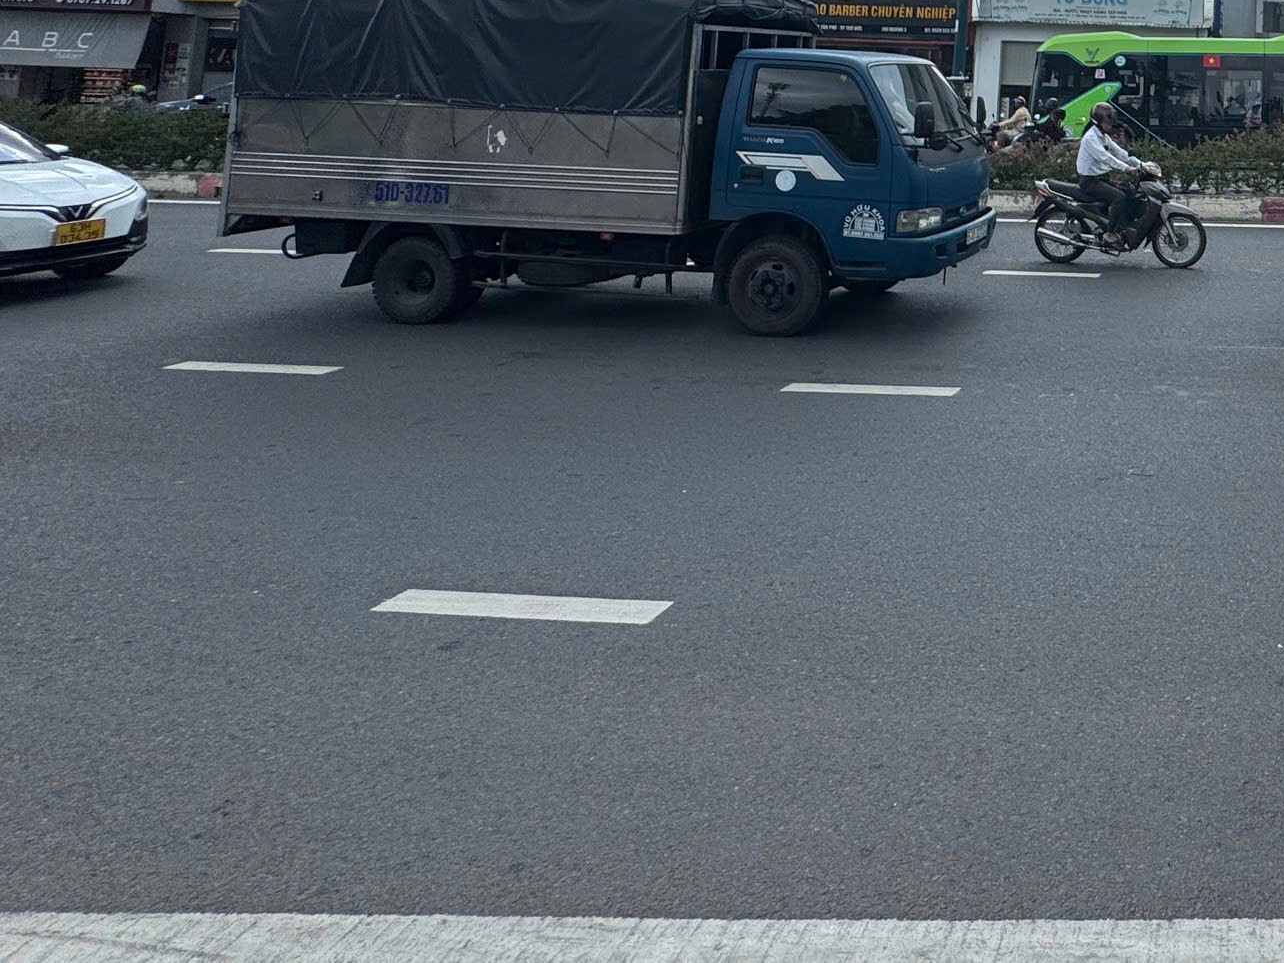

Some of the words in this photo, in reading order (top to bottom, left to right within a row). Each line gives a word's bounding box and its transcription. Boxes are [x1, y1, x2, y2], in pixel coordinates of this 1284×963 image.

[829, 5, 868, 18] BARBER
[871, 4, 912, 19] CHUYÊN
[916, 6, 956, 22] NGHIỆP
